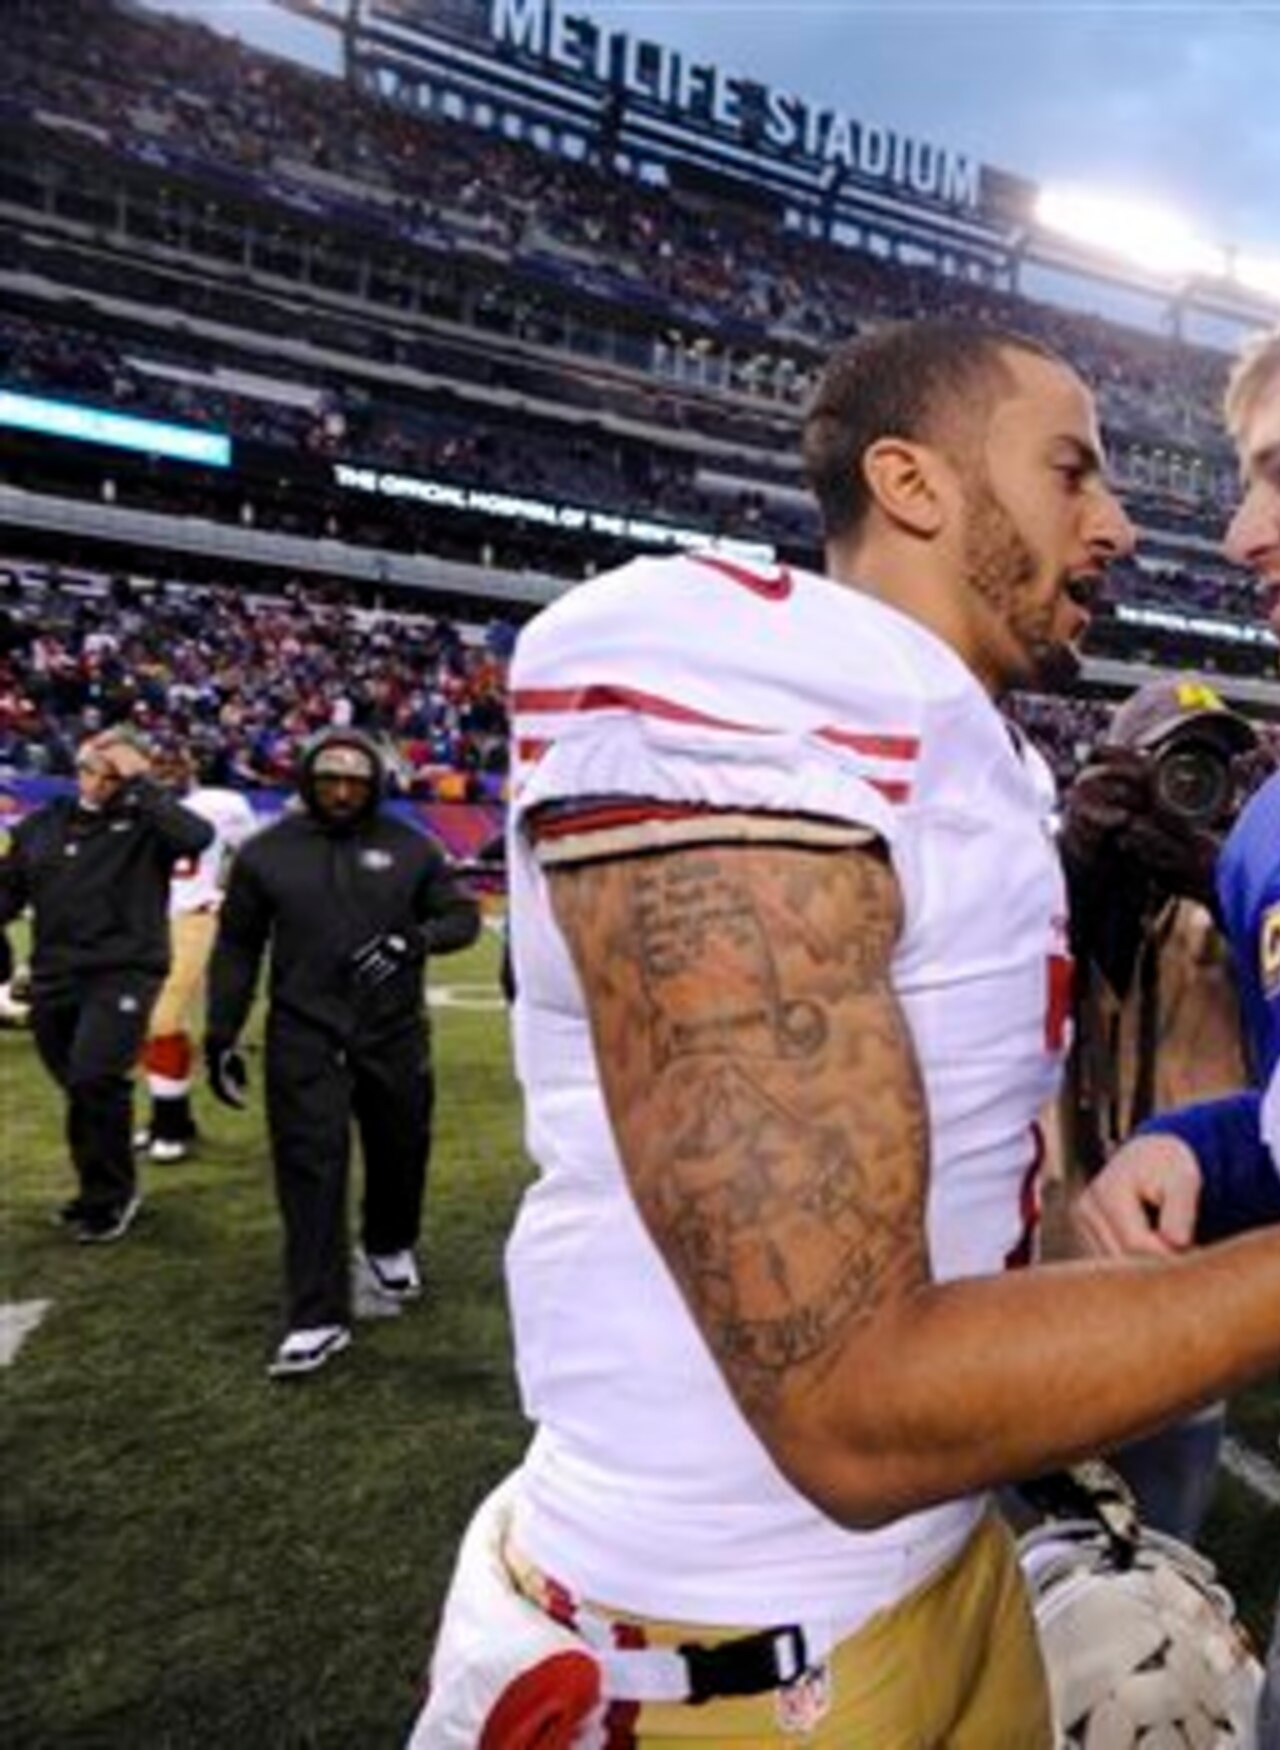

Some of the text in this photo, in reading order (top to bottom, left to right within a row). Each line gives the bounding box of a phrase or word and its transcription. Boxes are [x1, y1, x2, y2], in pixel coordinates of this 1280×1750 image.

[491, 0, 980, 206] METLIFE STADIUM
[334, 464, 376, 493] THE
